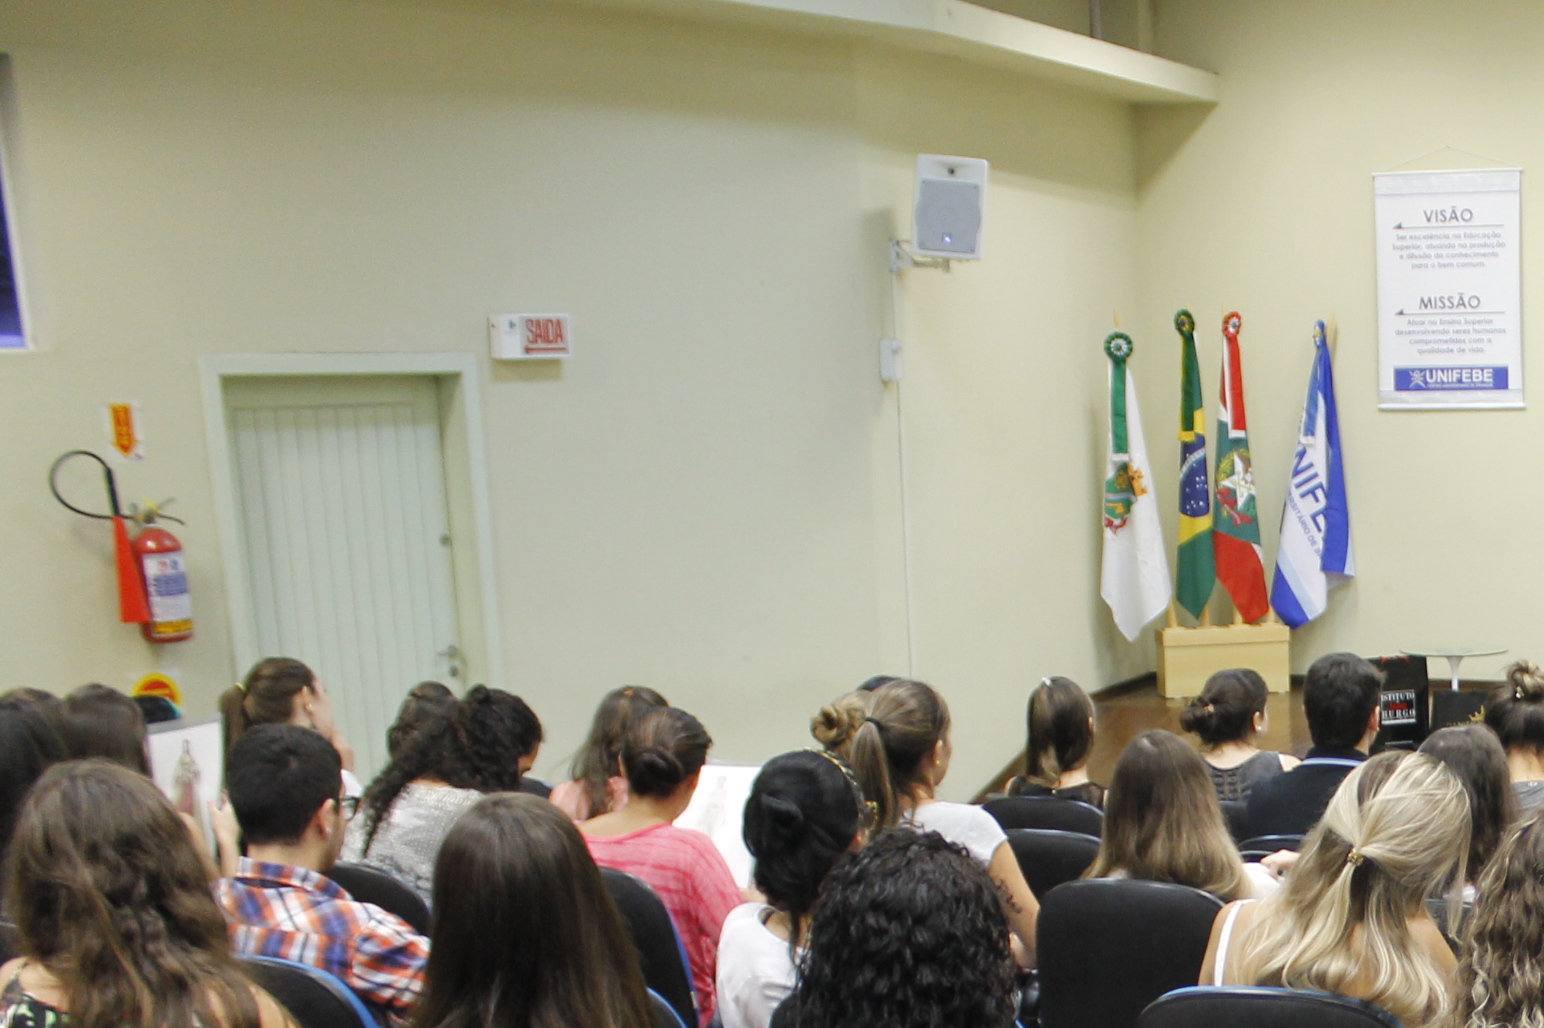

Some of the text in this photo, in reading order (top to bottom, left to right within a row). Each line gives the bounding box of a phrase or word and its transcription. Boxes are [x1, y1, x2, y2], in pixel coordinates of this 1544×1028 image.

[1423, 206, 1474, 223] VISÃO
[1409, 232, 1450, 240] excelência
[1463, 231, 1501, 240] Educação
[1469, 241, 1506, 250] produção
[1406, 251, 1432, 259] difusão
[1446, 250, 1499, 258] conhecimento
[1419, 293, 1481, 310] MISSÃO
[1464, 317, 1493, 326] Superior
[1395, 327, 1450, 335] desenvolvendo
[1409, 336, 1466, 345] comprometidos
[1417, 346, 1454, 354] qualidade
[1425, 368, 1494, 383] UNIFEBE
